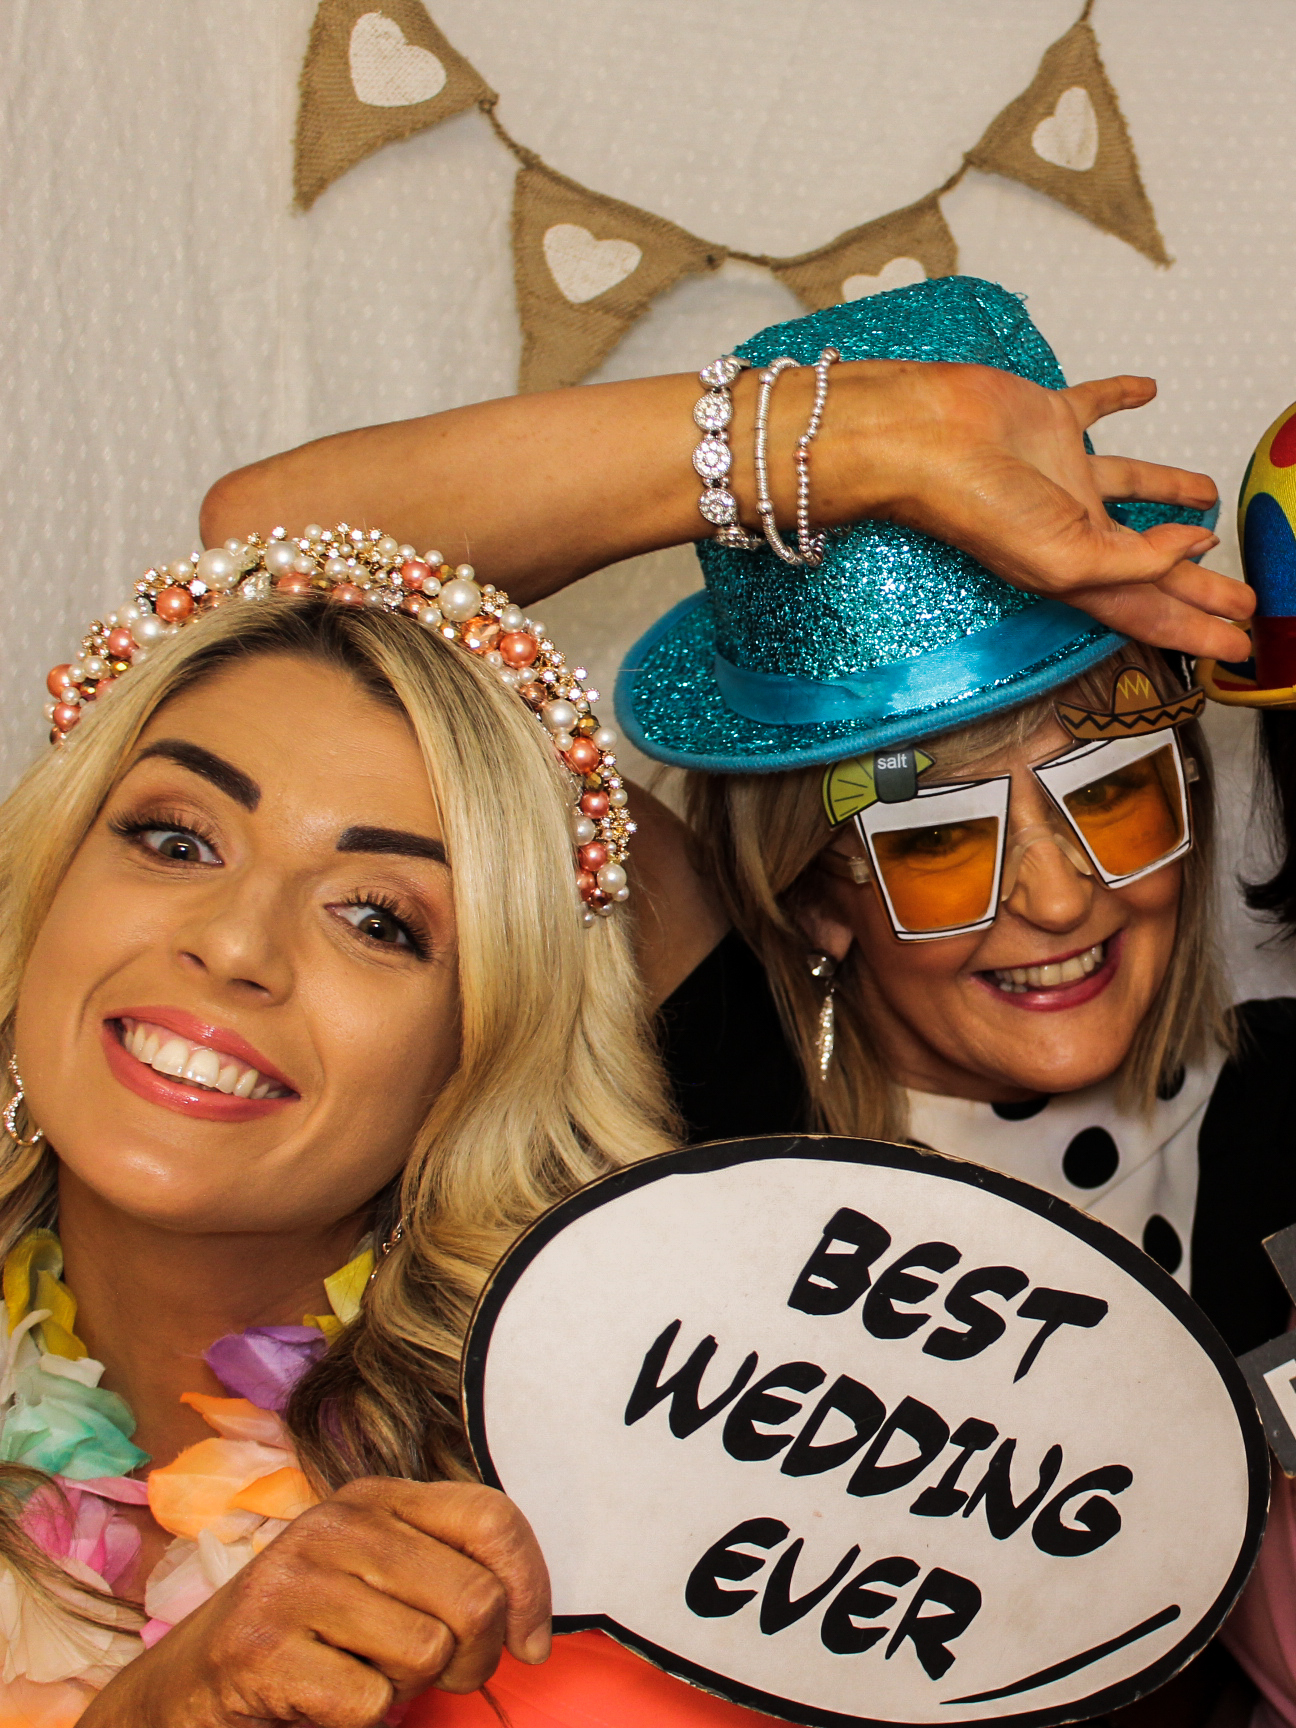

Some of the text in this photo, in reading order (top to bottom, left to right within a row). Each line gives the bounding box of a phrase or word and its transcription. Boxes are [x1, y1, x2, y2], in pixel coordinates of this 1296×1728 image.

[877, 753, 908, 769] salt
[787, 1206, 1108, 1383] BEST
[624, 1319, 1134, 1558] WEDDING
[684, 1516, 982, 1681] EVER
